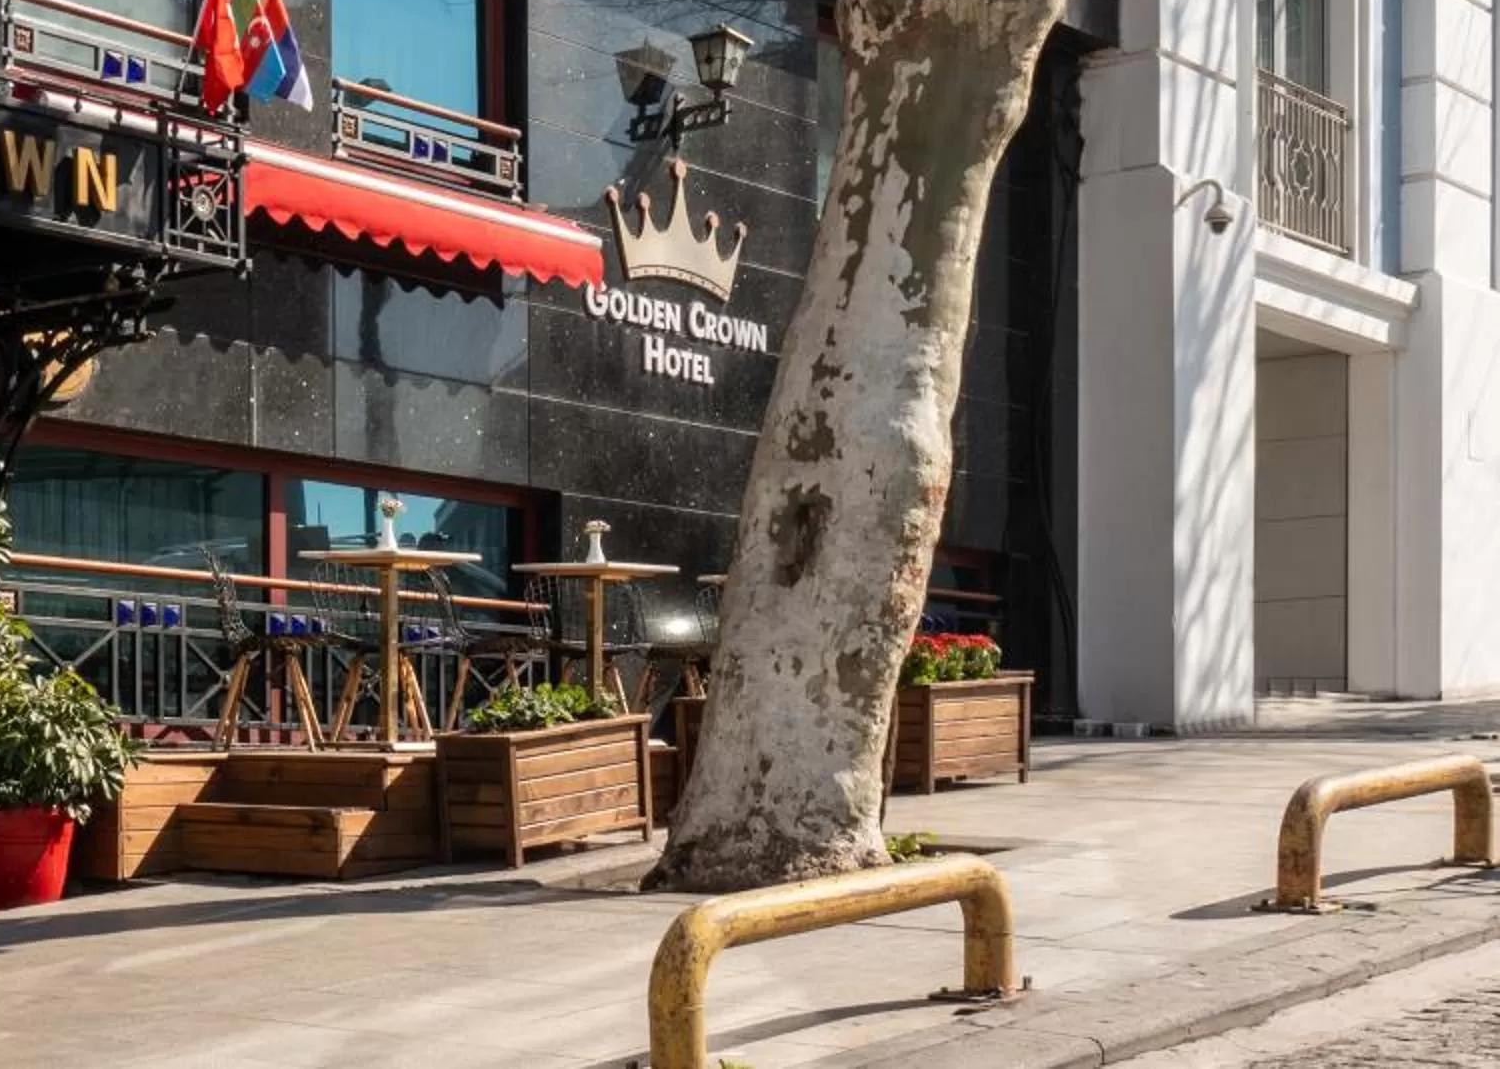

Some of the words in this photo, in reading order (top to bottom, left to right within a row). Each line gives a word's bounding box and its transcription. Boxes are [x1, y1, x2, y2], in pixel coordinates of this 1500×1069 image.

[585, 282, 681, 331] GOLDEN
[689, 301, 767, 351] CROWN
[643, 333, 714, 384] HOTEL
